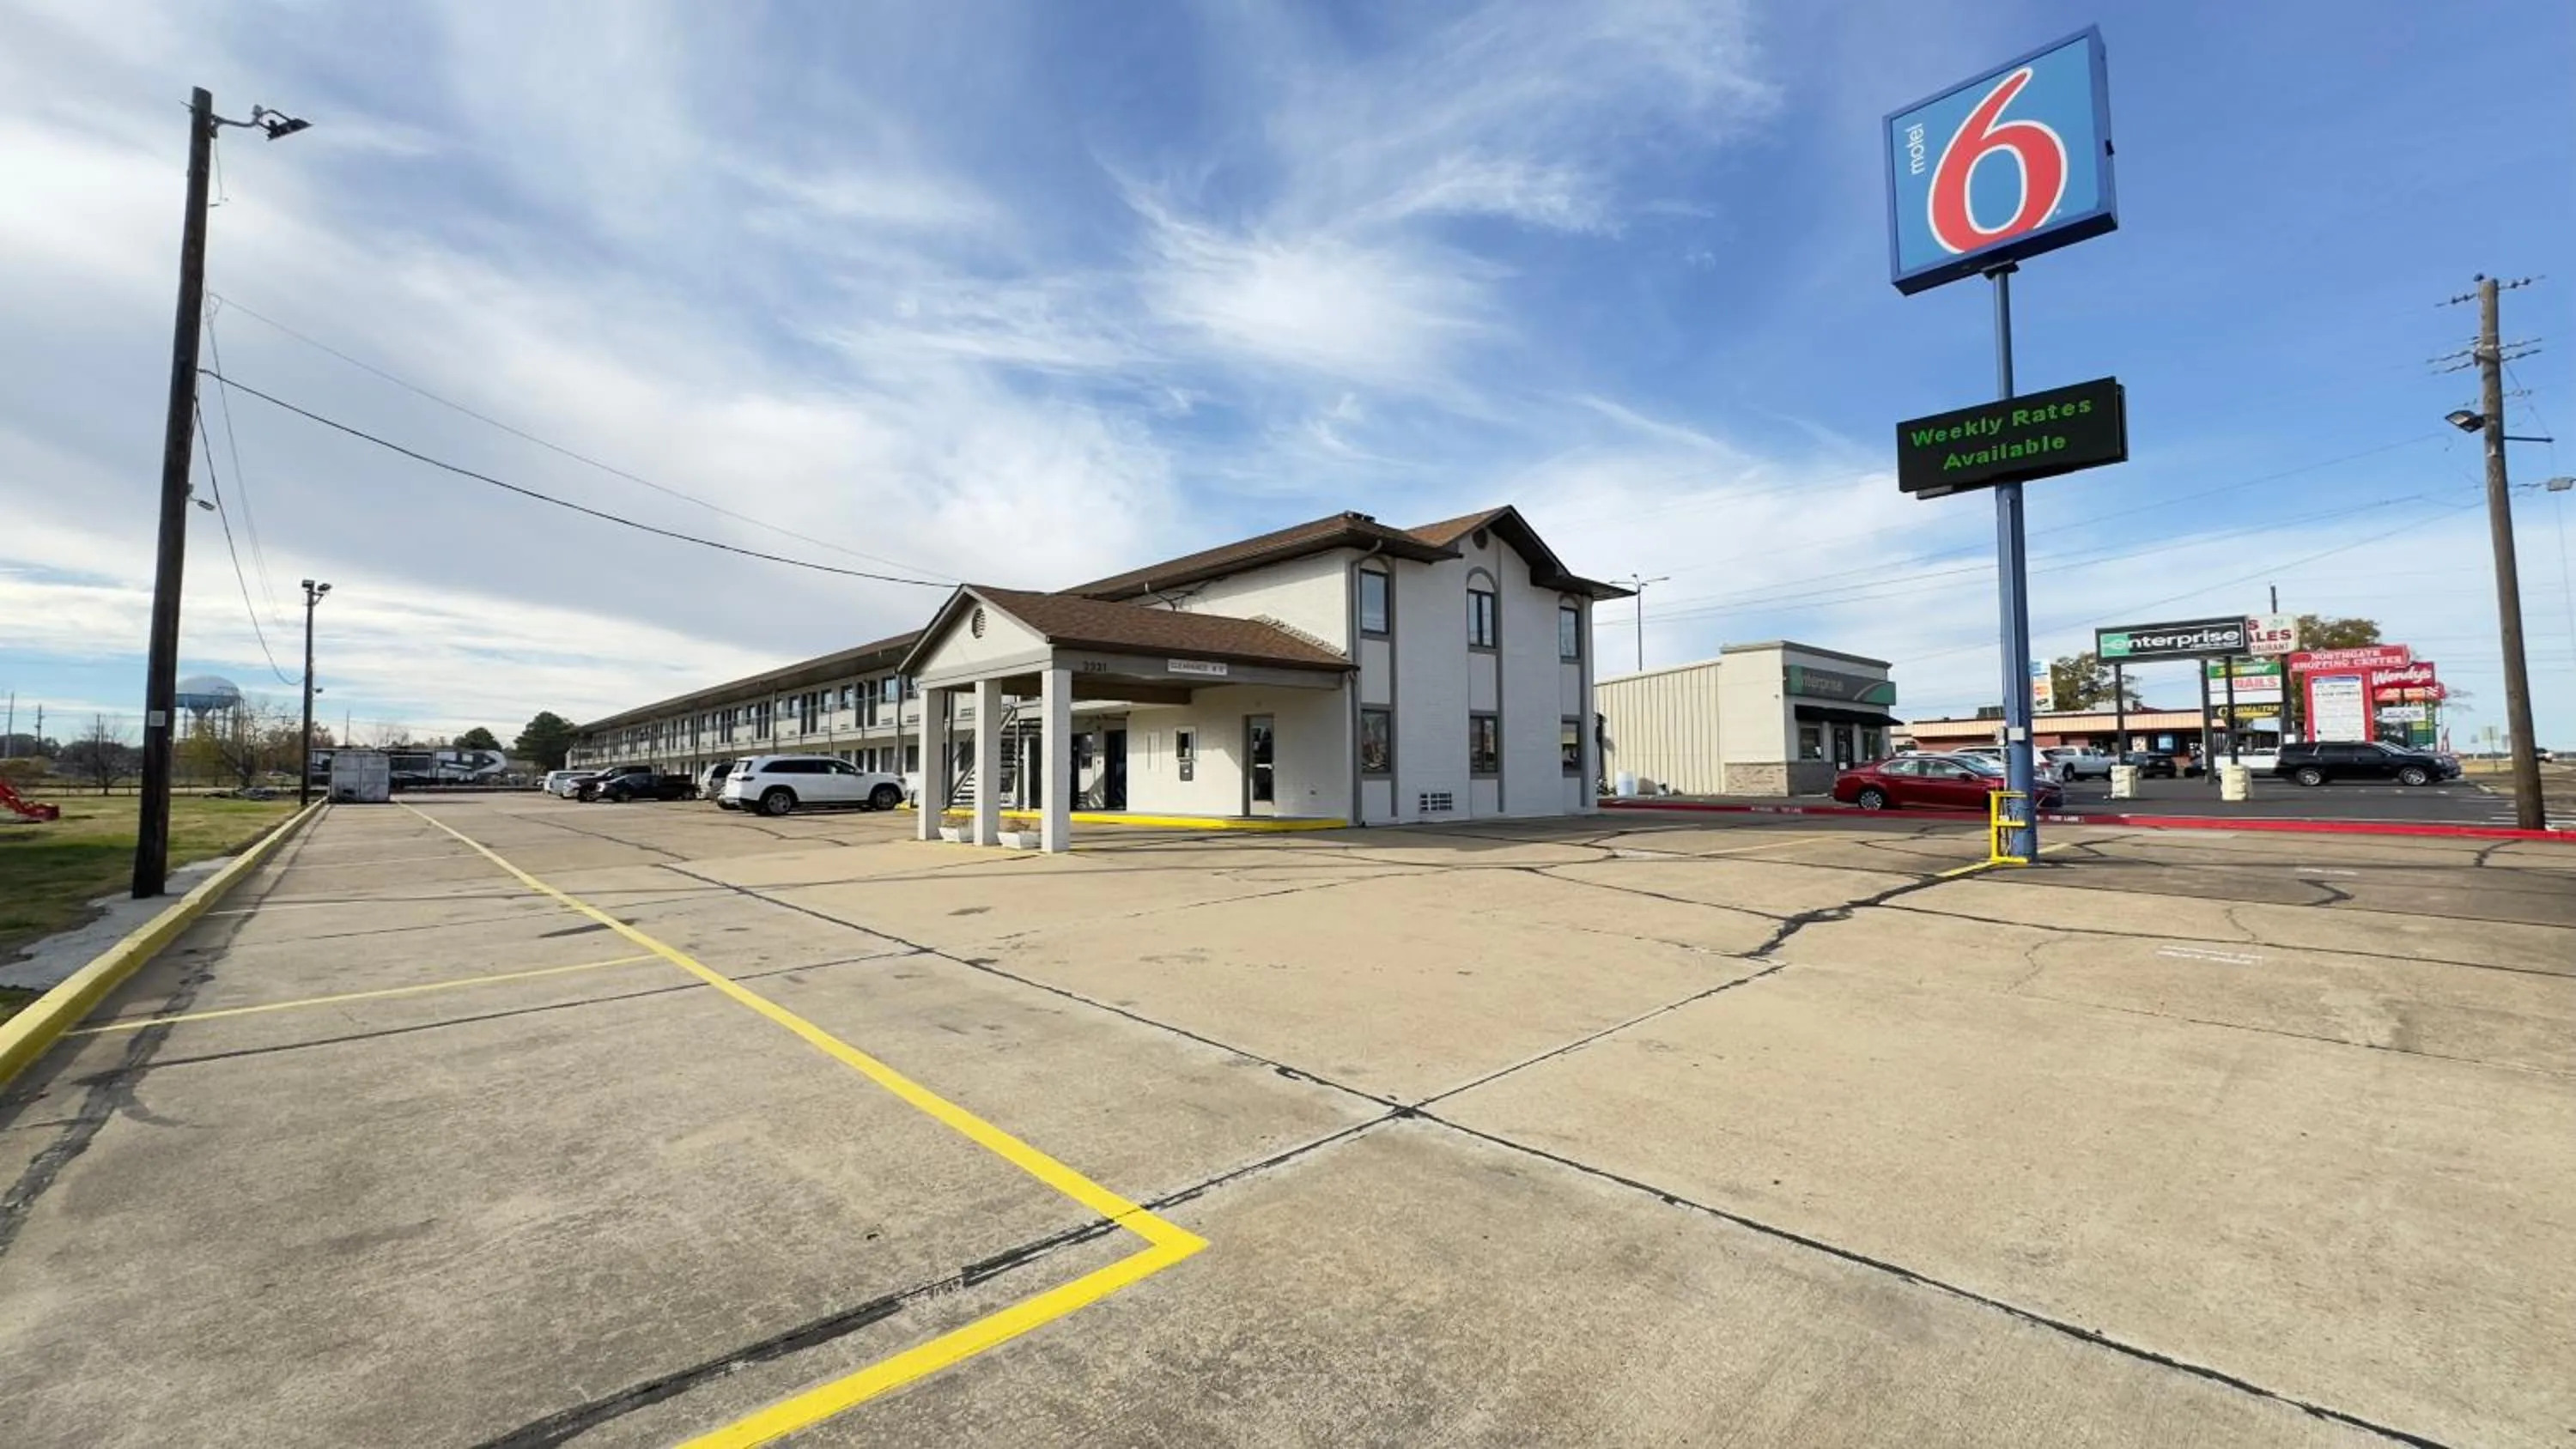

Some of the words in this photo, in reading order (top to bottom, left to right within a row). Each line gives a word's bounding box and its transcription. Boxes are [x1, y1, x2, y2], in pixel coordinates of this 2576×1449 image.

[1905, 123, 1925, 175] motel
[1927, 67, 2068, 254] 6
[1911, 415, 2003, 448] Weekly
[2012, 399, 2093, 427] Rates
[1943, 435, 2068, 470] Available
[2105, 628, 2240, 651] enterprise
[2354, 655, 2403, 666] CENTER
[2372, 665, 2433, 687] Wendy's
